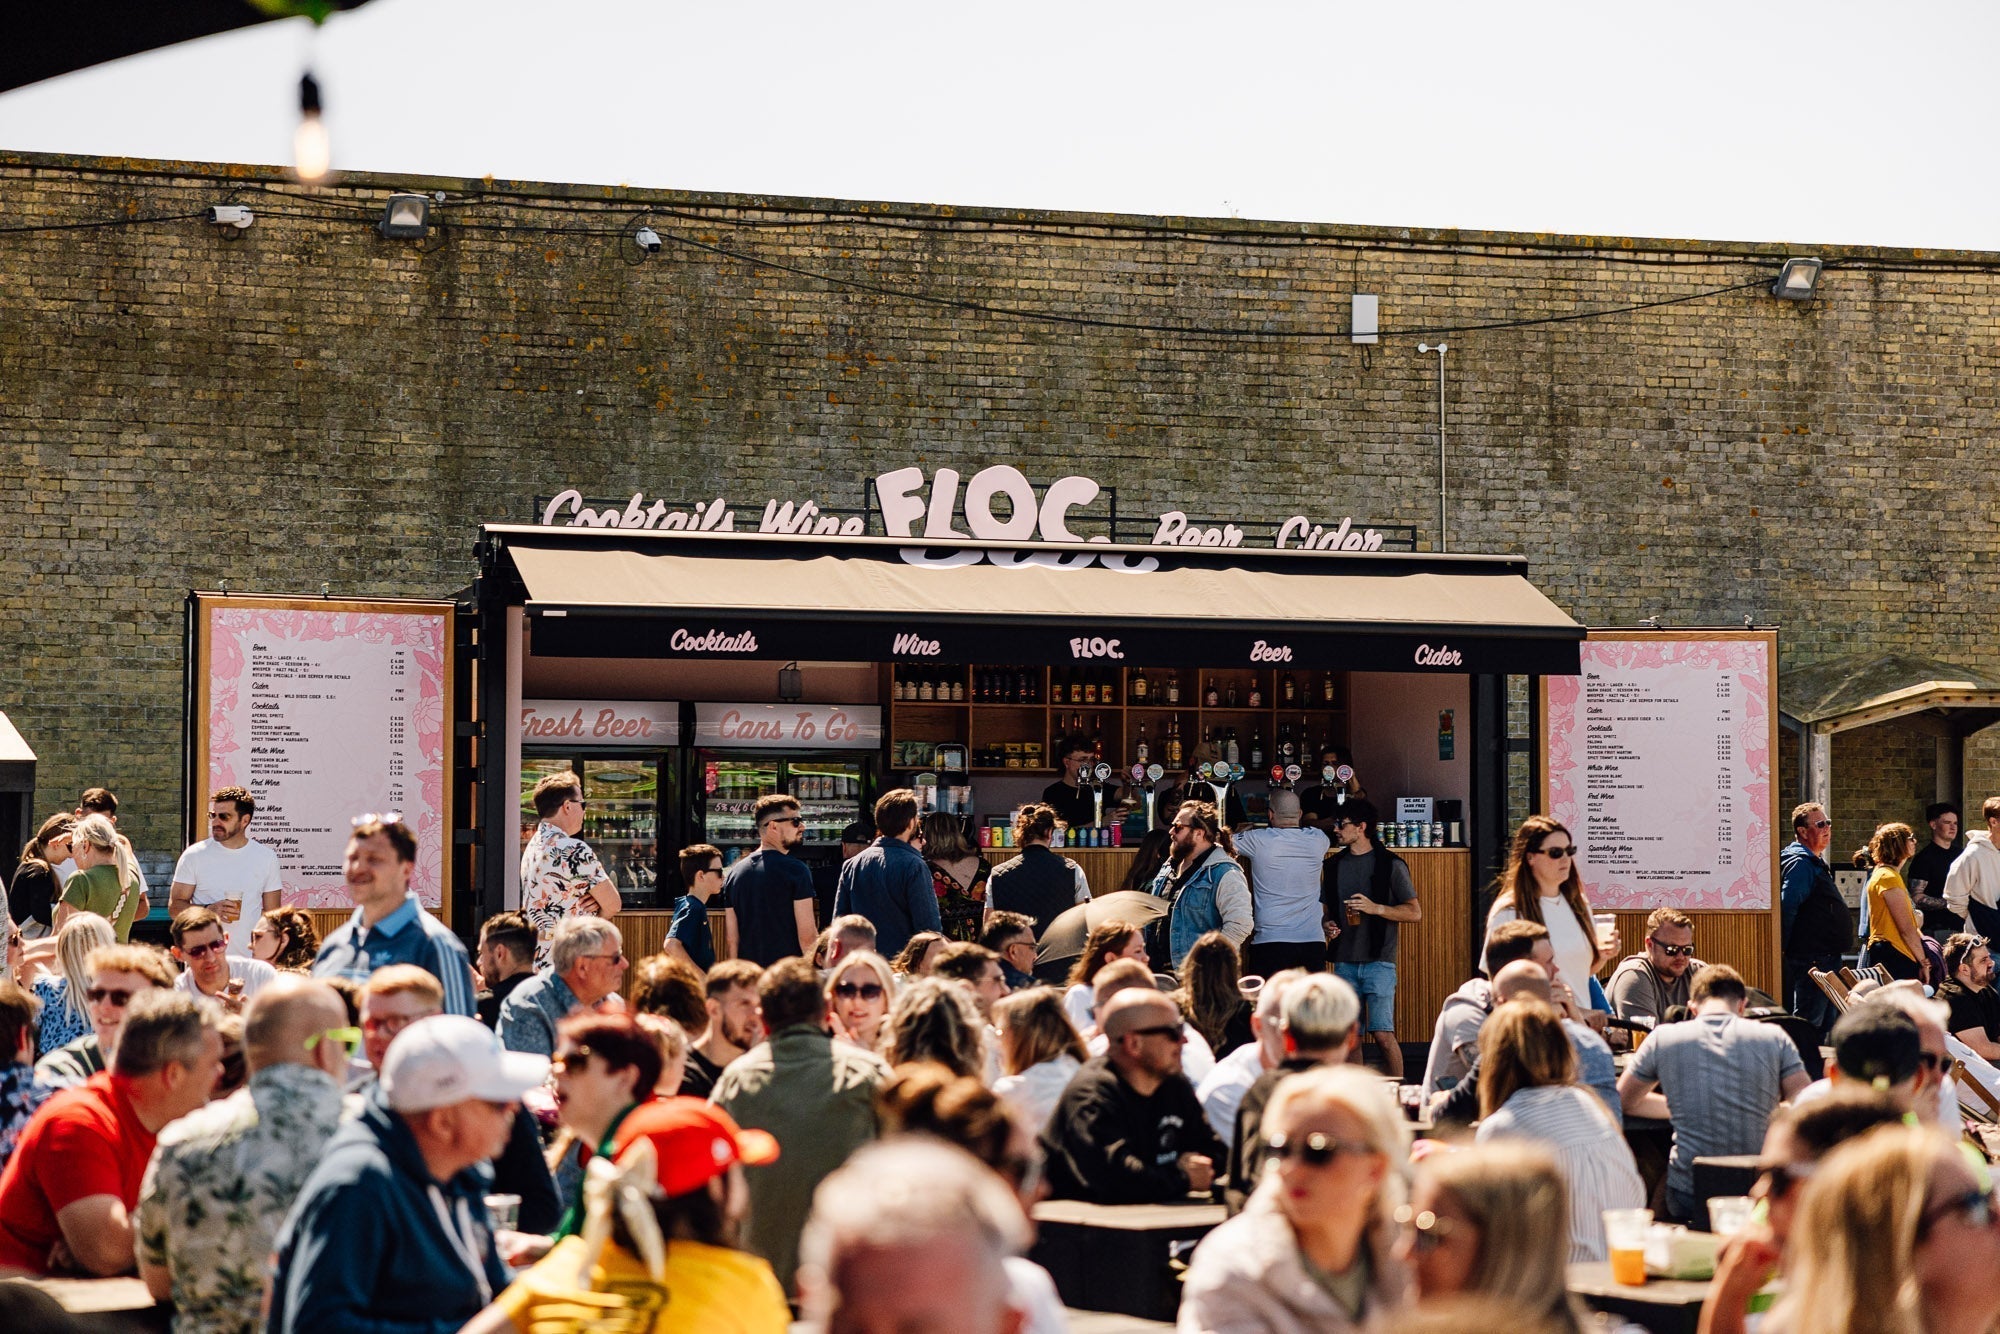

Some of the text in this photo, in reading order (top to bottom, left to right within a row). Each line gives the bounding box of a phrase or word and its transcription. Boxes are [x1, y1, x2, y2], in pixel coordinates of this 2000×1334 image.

[670, 628, 758, 652] Cocktails
[893, 632, 941, 656] Wine
[1069, 637, 1124, 659] FLOC.
[1250, 640, 1293, 662] Beer
[1414, 644, 1462, 666] Cider
[593, 708, 652, 738] Beer
[719, 709, 858, 741] Cans To Go
[1588, 845, 1617, 854] Sparkling
